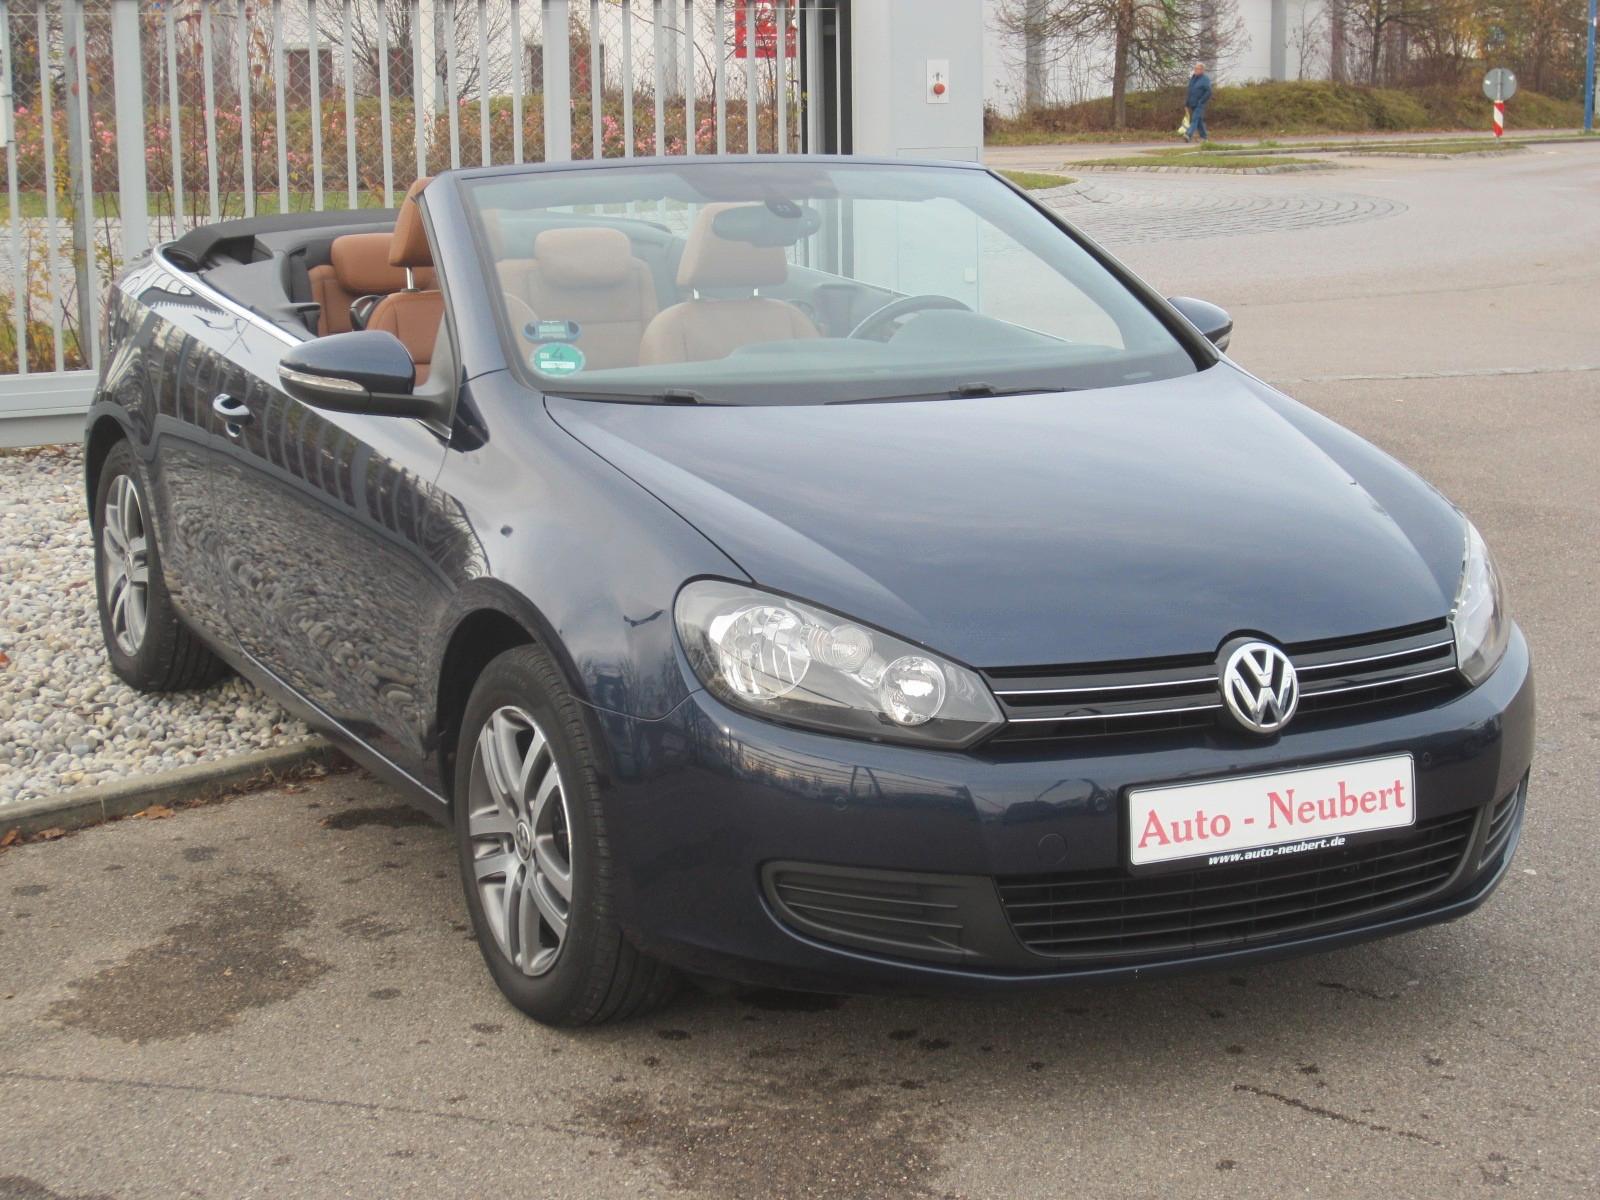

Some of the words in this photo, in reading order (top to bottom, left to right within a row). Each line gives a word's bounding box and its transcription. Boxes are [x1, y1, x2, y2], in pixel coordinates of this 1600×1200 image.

[551, 347, 564, 360] 4
[1138, 809, 1231, 848] Auto
[1267, 779, 1406, 829] Neubert
[1208, 836, 1346, 865] www.auto-neubert.de
